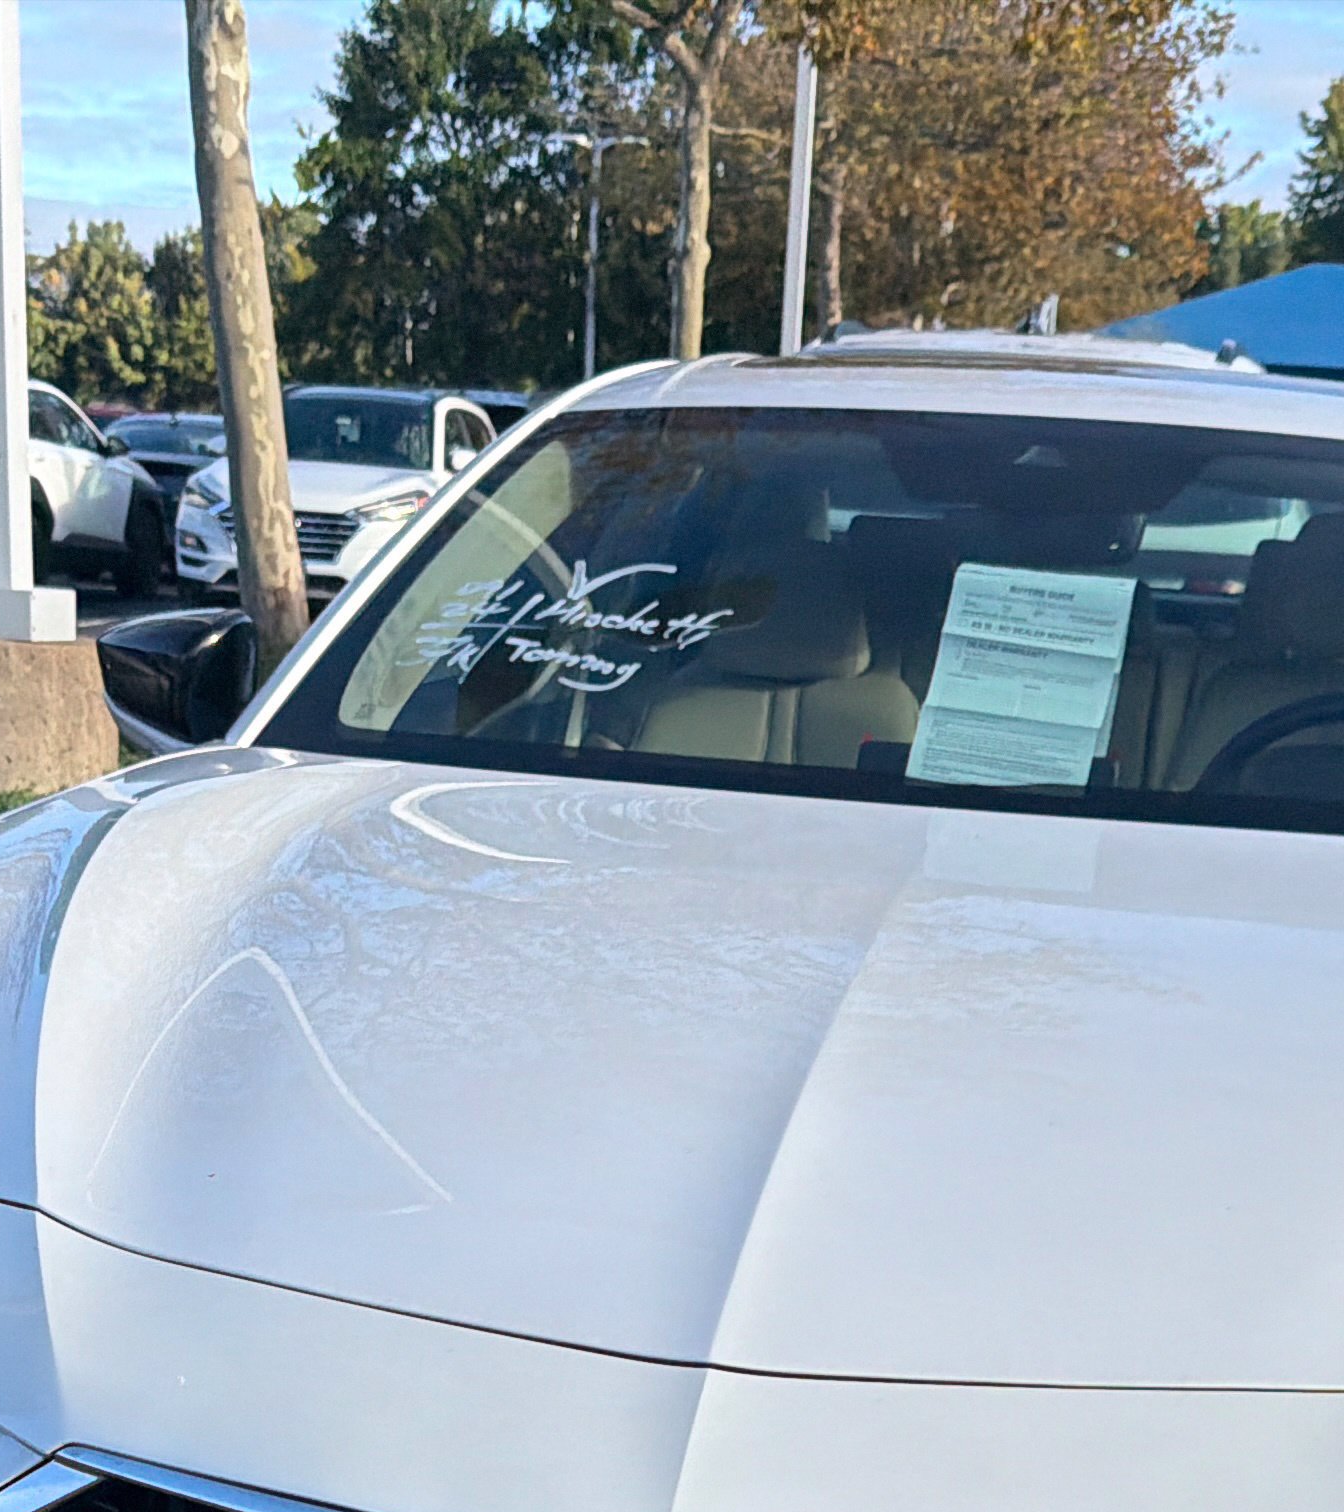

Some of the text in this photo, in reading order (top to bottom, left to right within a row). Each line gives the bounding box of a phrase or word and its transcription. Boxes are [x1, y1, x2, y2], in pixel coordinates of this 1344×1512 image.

[1012, 626, 1046, 639] DEALER
[1047, 632, 1095, 645] WARRANTY
[966, 638, 1000, 651] DEALER
